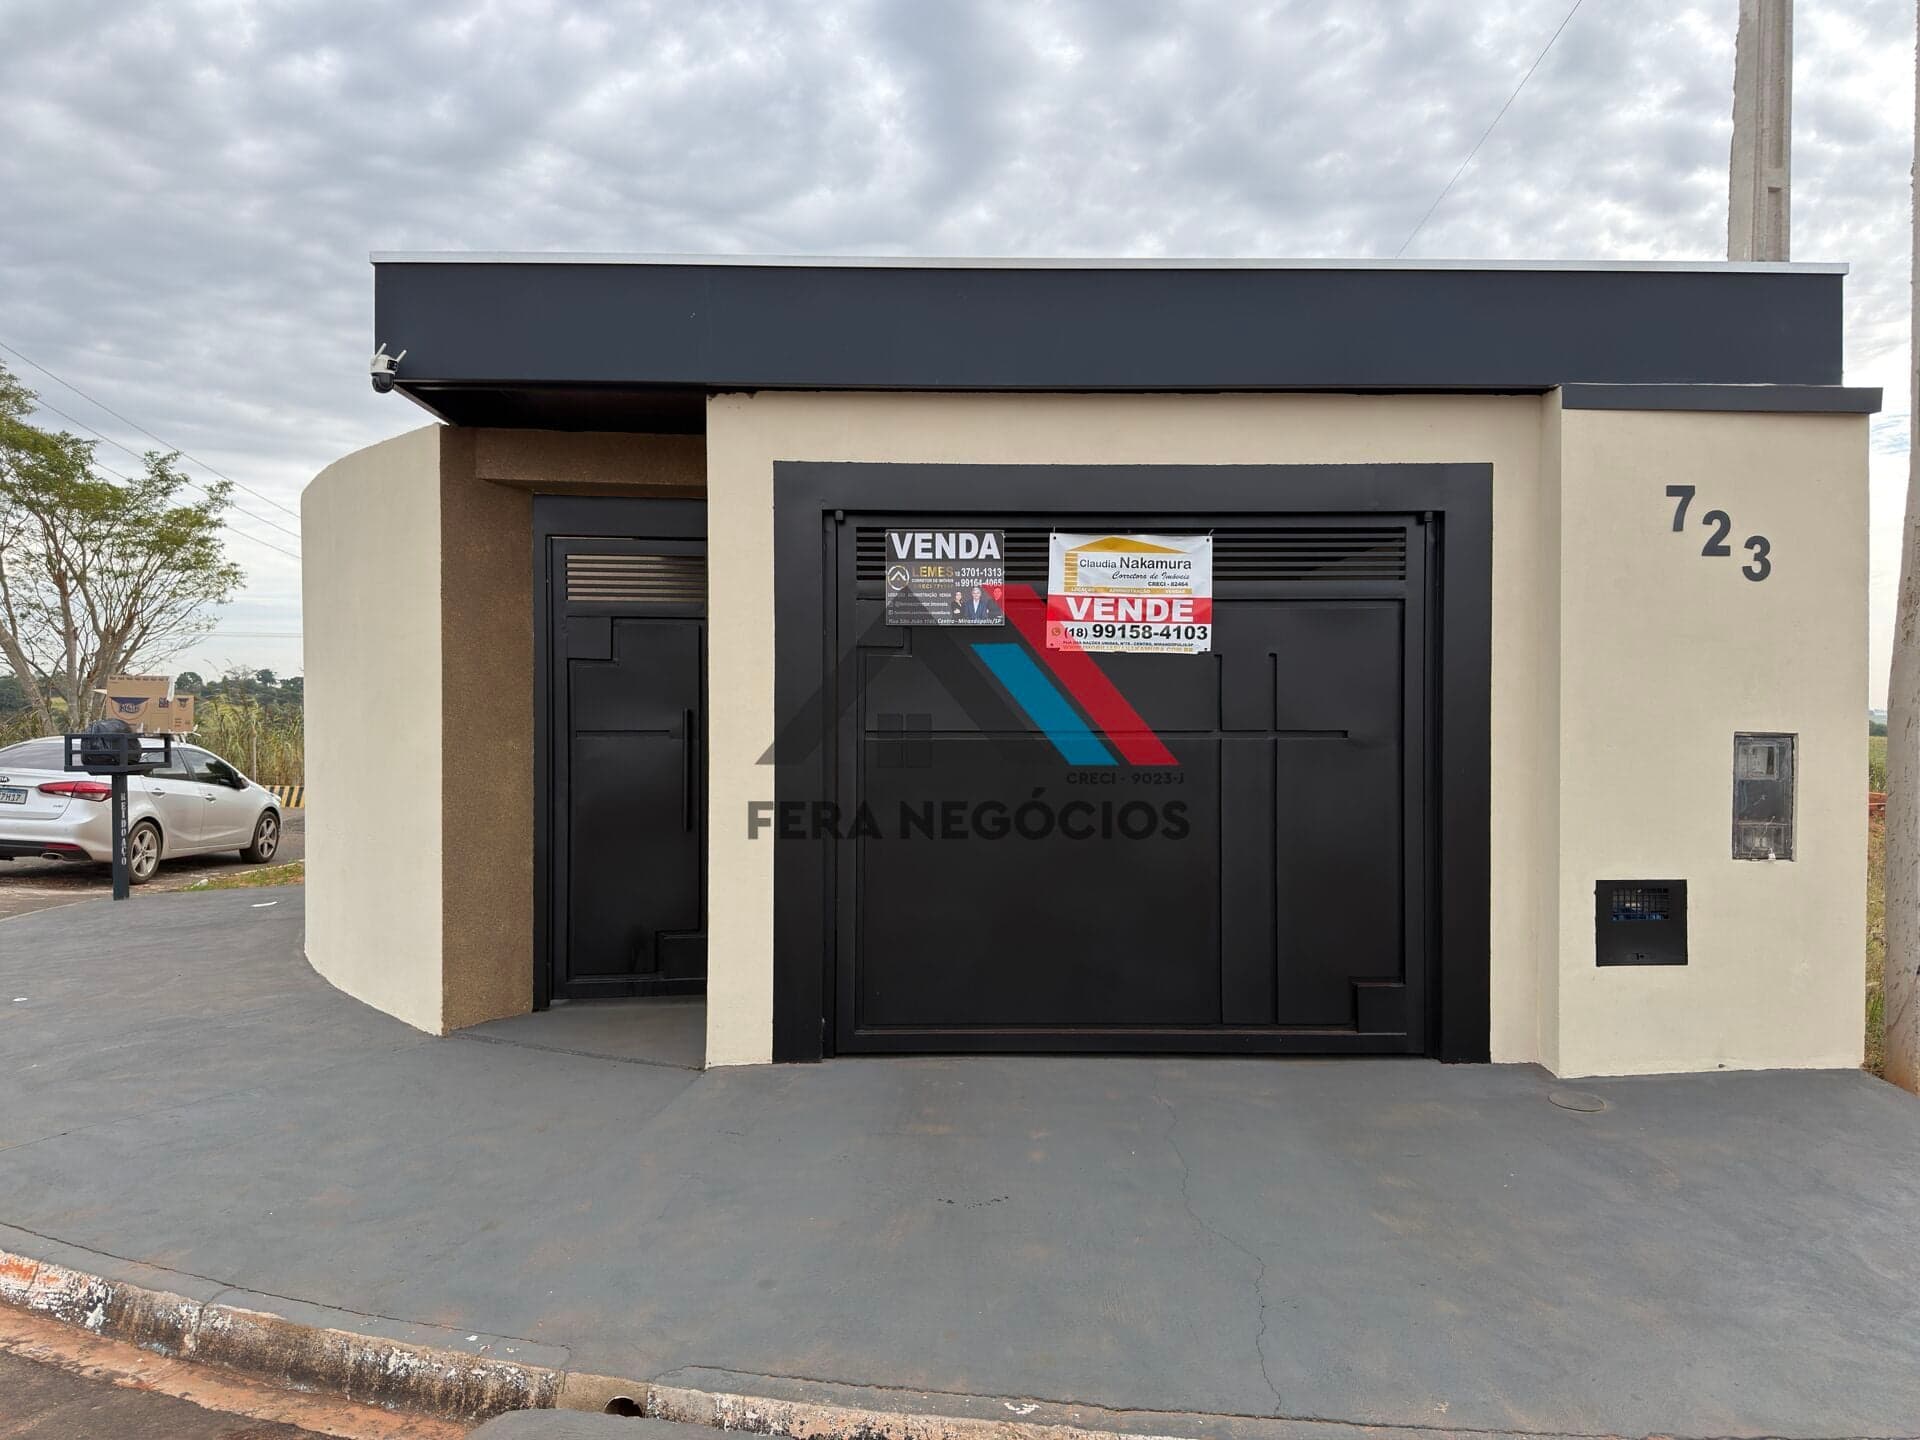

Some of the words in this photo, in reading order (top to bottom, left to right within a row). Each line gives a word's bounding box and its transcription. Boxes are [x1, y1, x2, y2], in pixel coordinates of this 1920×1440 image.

[1665, 485, 1771, 582] 723
[890, 532, 1001, 559] VENDA
[1079, 559, 1117, 569] Claudia
[1120, 557, 1192, 569] Nakamura
[912, 566, 954, 577] LEMES
[961, 567, 1002, 577] 3701-1313
[1112, 571, 1147, 580] Corretora
[1150, 572, 1158, 580] de
[1066, 596, 1194, 623] VENDE
[1064, 626, 1088, 639] (18)
[1092, 624, 1208, 640] 99158-4103
